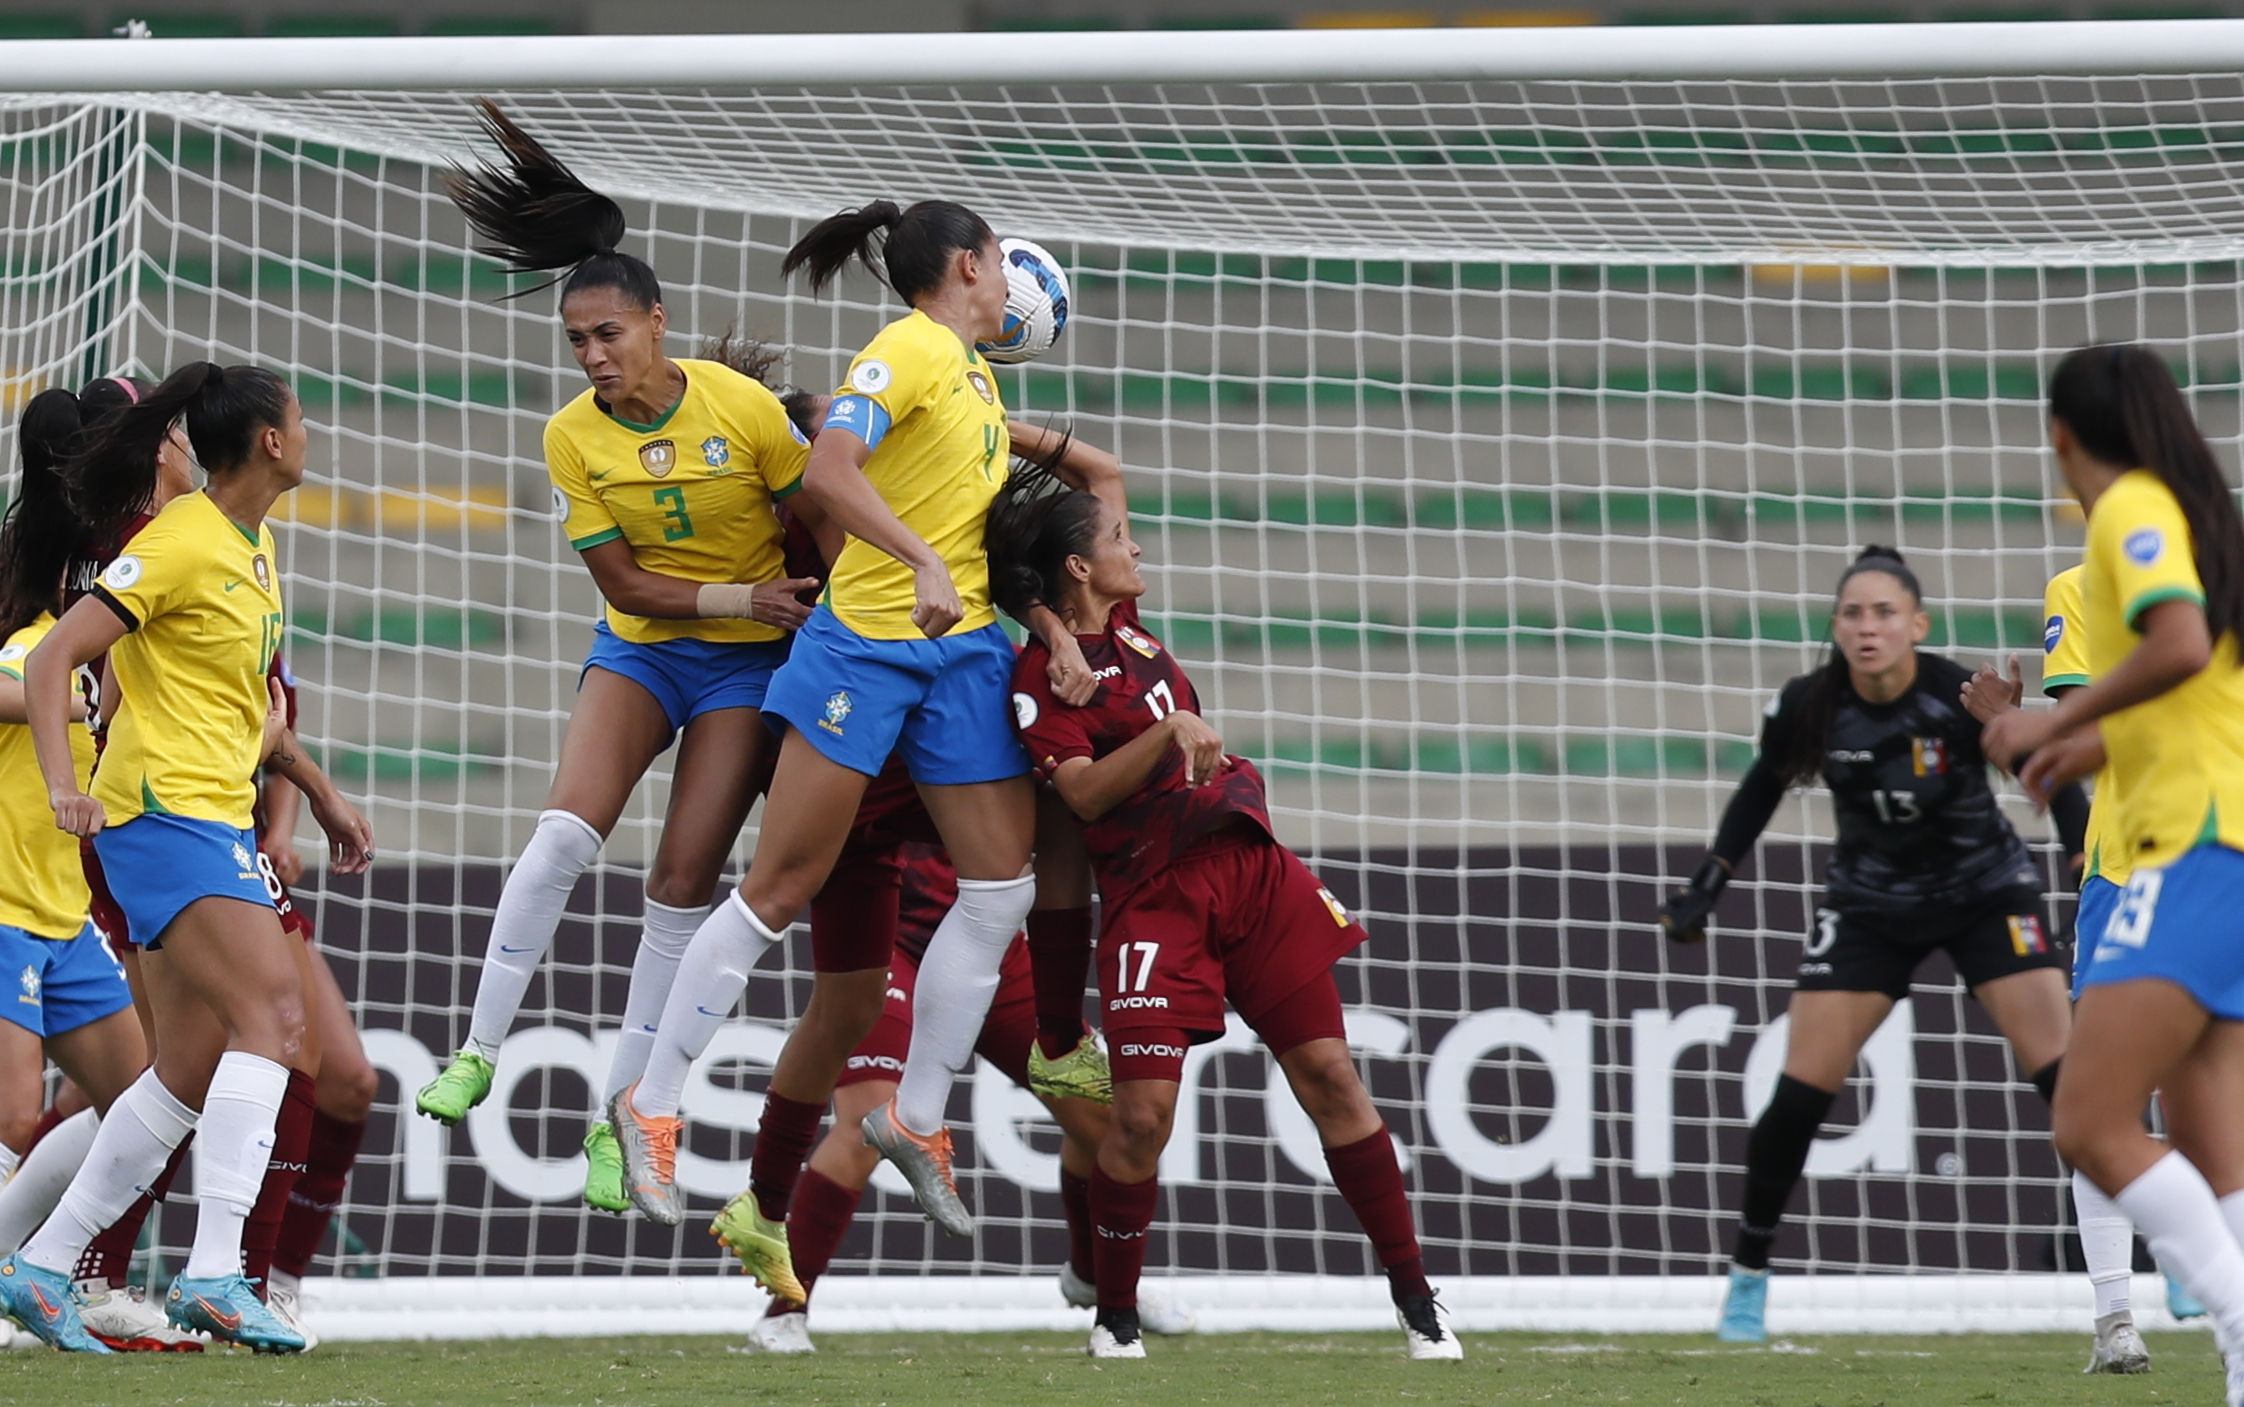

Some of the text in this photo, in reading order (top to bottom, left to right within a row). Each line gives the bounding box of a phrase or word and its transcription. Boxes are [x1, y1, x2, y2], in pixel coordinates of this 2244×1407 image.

[653, 485, 695, 543] 3
[1144, 679, 1176, 722] 17
[1872, 789, 1922, 823] 13
[257, 851, 283, 900] 8
[1118, 941, 1160, 993] 17
[1110, 996, 1168, 1011] GIVOVA
[192, 996, 1913, 1203] asercard
